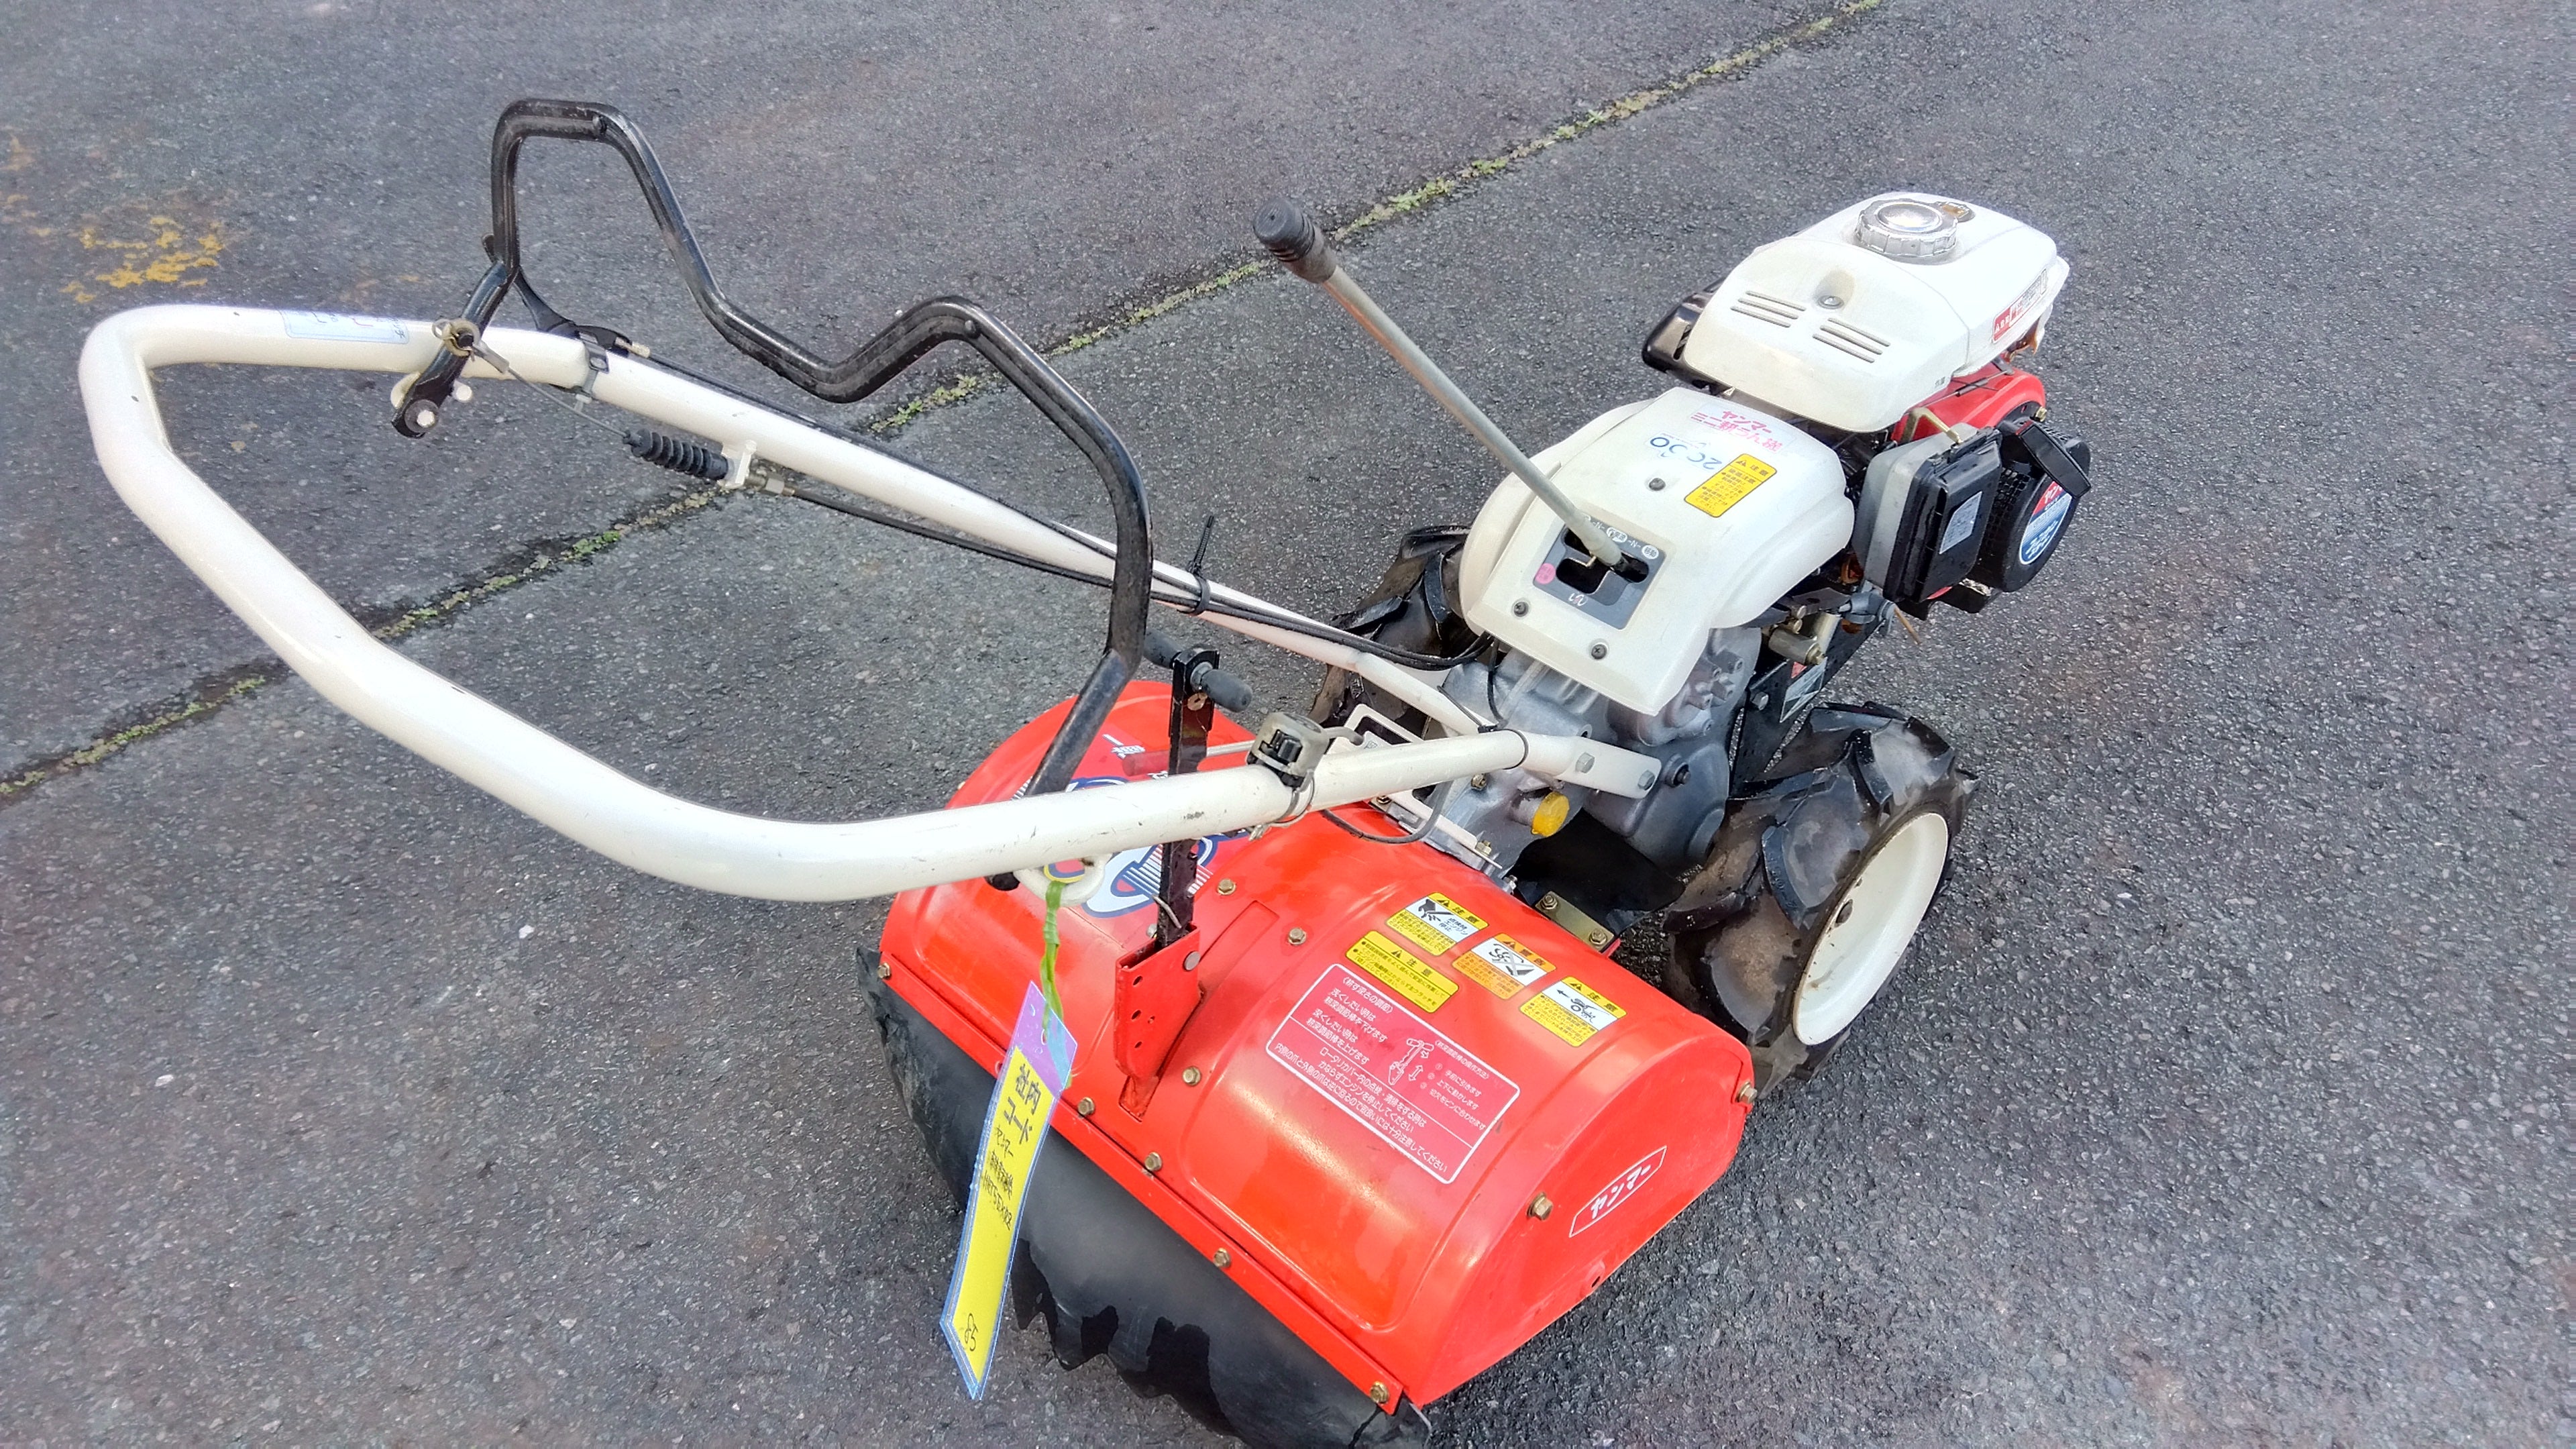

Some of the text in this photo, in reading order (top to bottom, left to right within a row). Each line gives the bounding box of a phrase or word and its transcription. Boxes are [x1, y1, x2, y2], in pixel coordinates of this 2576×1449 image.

[1717, 409, 1775, 437] ヤンマー
[1437, 922, 1454, 932] 停止
[1442, 919, 1469, 936] エンジン
[1450, 905, 1481, 924] 注意
[1405, 957, 1434, 978] 注意
[1328, 986, 1378, 1024] 浅くしたい時は
[1585, 991, 1619, 1012] 注意
[1311, 1007, 1360, 1044] 深くしたい時は
[1016, 1063, 1041, 1115] 社内
[1316, 1059, 1416, 1134] かならずエンジンを停止してください
[1435, 1077, 1480, 1112] 上下に動かします
[1004, 1096, 1032, 1144] コード
[1591, 1165, 1652, 1219] ヤンマー
